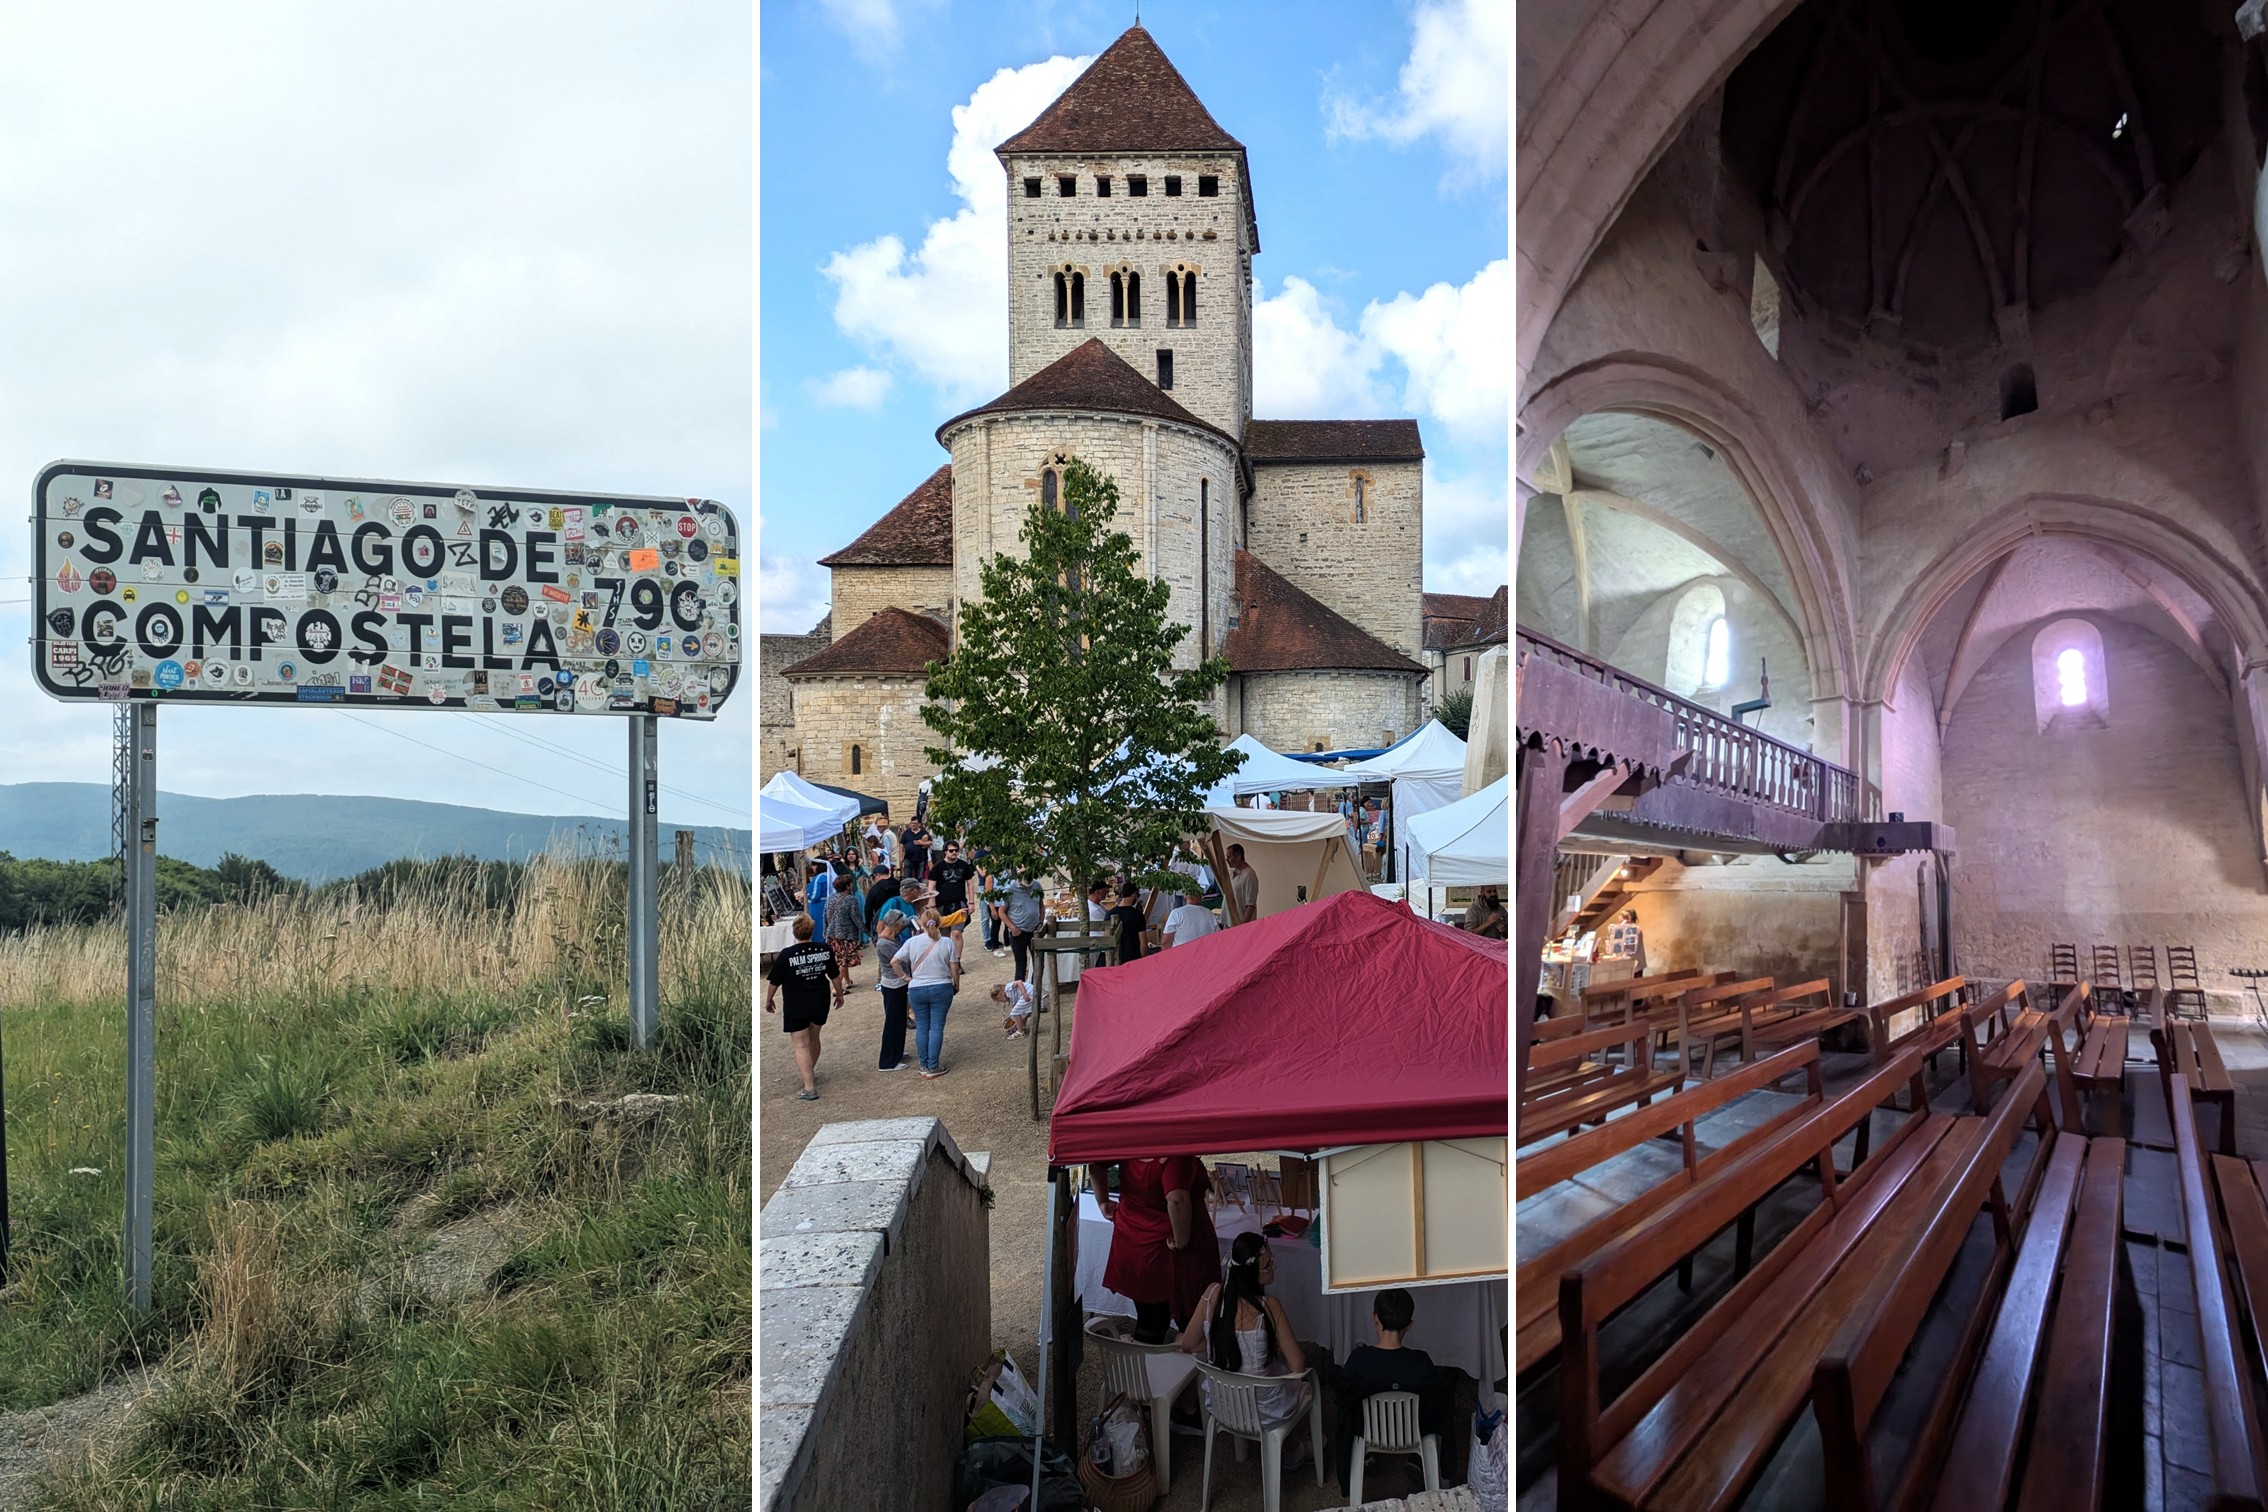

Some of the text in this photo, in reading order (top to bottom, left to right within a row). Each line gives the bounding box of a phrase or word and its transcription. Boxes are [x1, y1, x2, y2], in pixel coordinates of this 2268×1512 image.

[678, 522, 696, 532] STOP
[79, 507, 446, 578] SANTIAGO
[480, 528, 559, 584] DE
[81, 599, 563, 672] COMPOSTELA
[53, 647, 77, 655] CARPI
[789, 951, 830, 967] PALM SPRINGS
